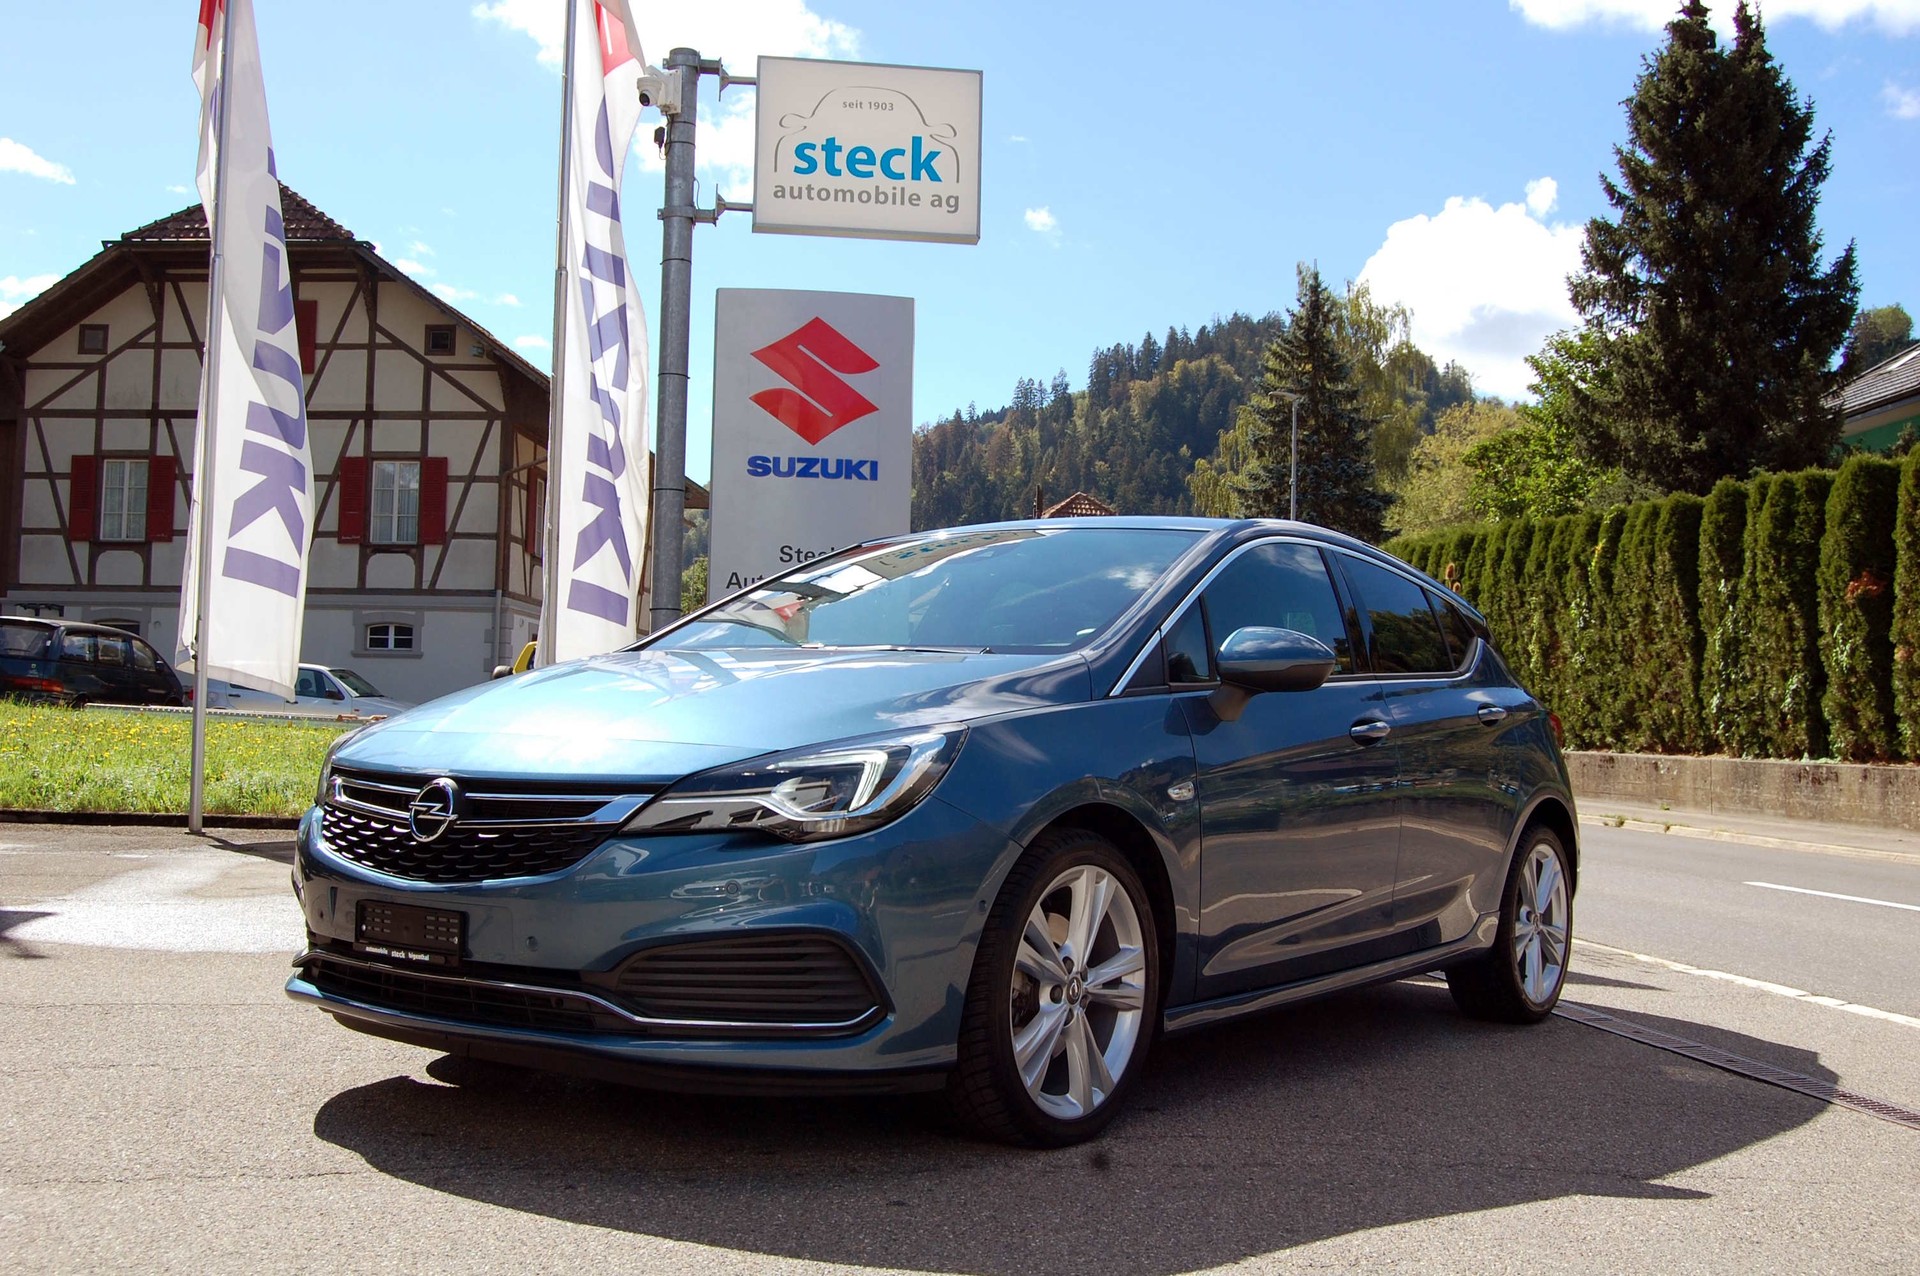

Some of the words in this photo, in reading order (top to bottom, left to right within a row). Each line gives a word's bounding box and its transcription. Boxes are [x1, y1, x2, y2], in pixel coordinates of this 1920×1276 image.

[842, 99, 863, 110] seit
[867, 101, 894, 112] 1903
[793, 135, 943, 183] steck
[773, 183, 922, 207] automobile
[930, 192, 960, 214] ag
[747, 455, 879, 482] SUZUKI
[779, 544, 837, 563] Ste
[391, 951, 406, 959] steck
